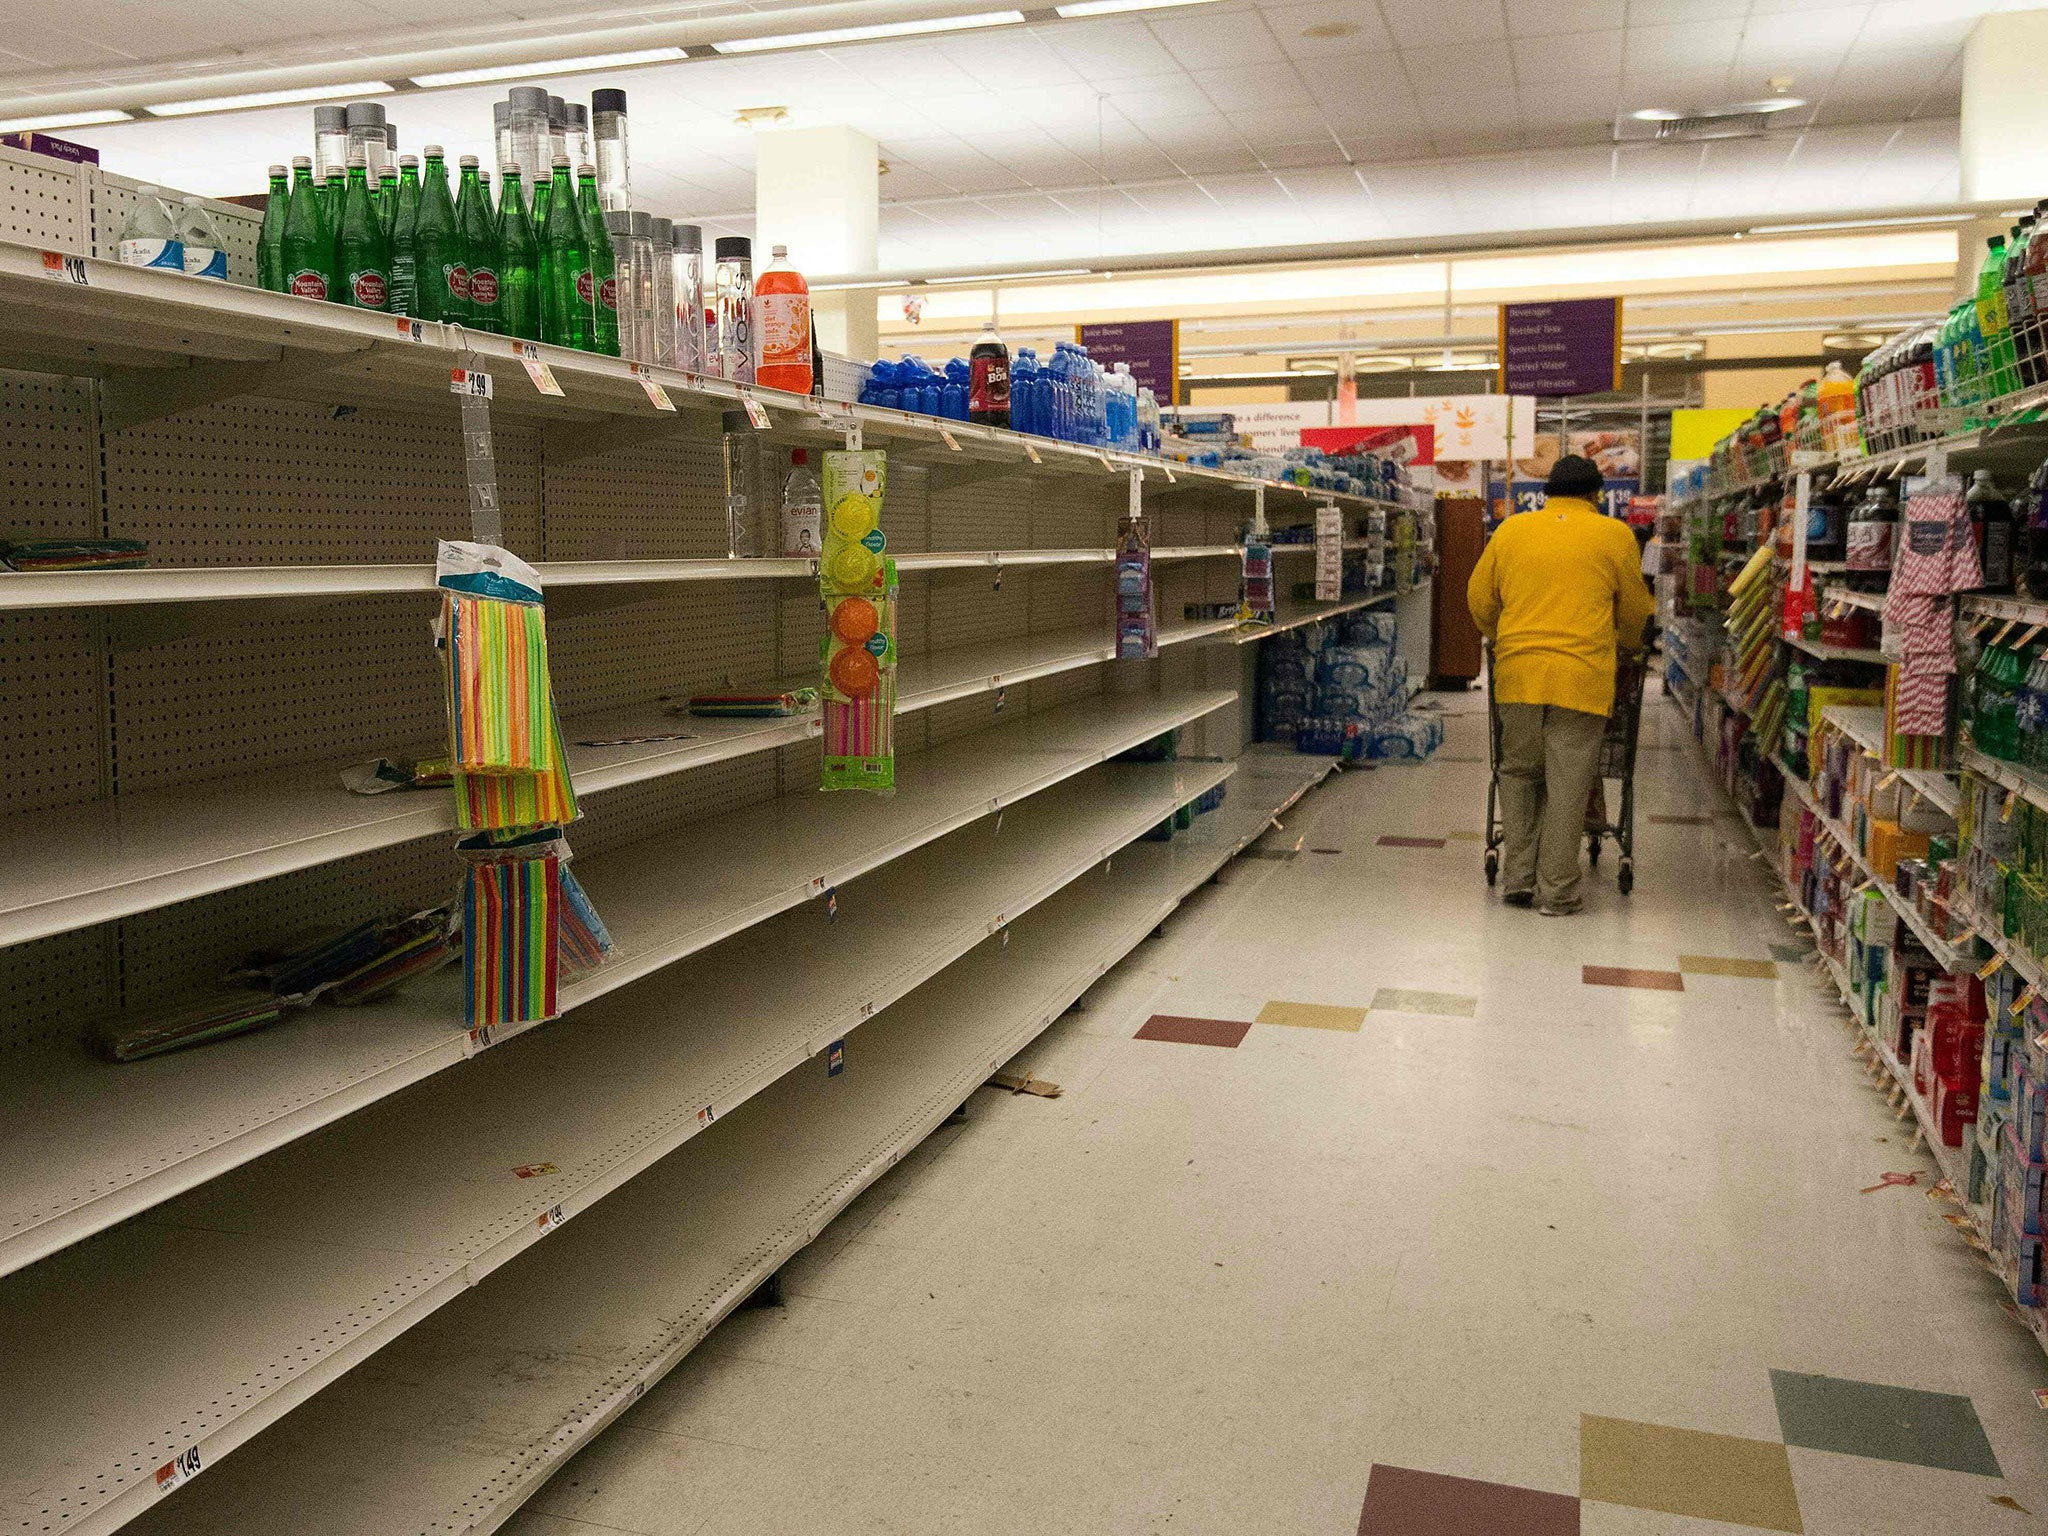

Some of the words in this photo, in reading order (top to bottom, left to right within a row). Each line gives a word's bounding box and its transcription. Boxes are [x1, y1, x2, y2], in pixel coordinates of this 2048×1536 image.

[734, 271, 749, 370] VOSS
[764, 321, 786, 330] orange
[1508, 362, 1539, 372] Bottled
[1540, 361, 1567, 371] Water
[1508, 381, 1535, 389] Water
[1253, 410, 1301, 422] difference
[790, 505, 818, 516] evian
[177, 1445, 202, 1478] $1.49
